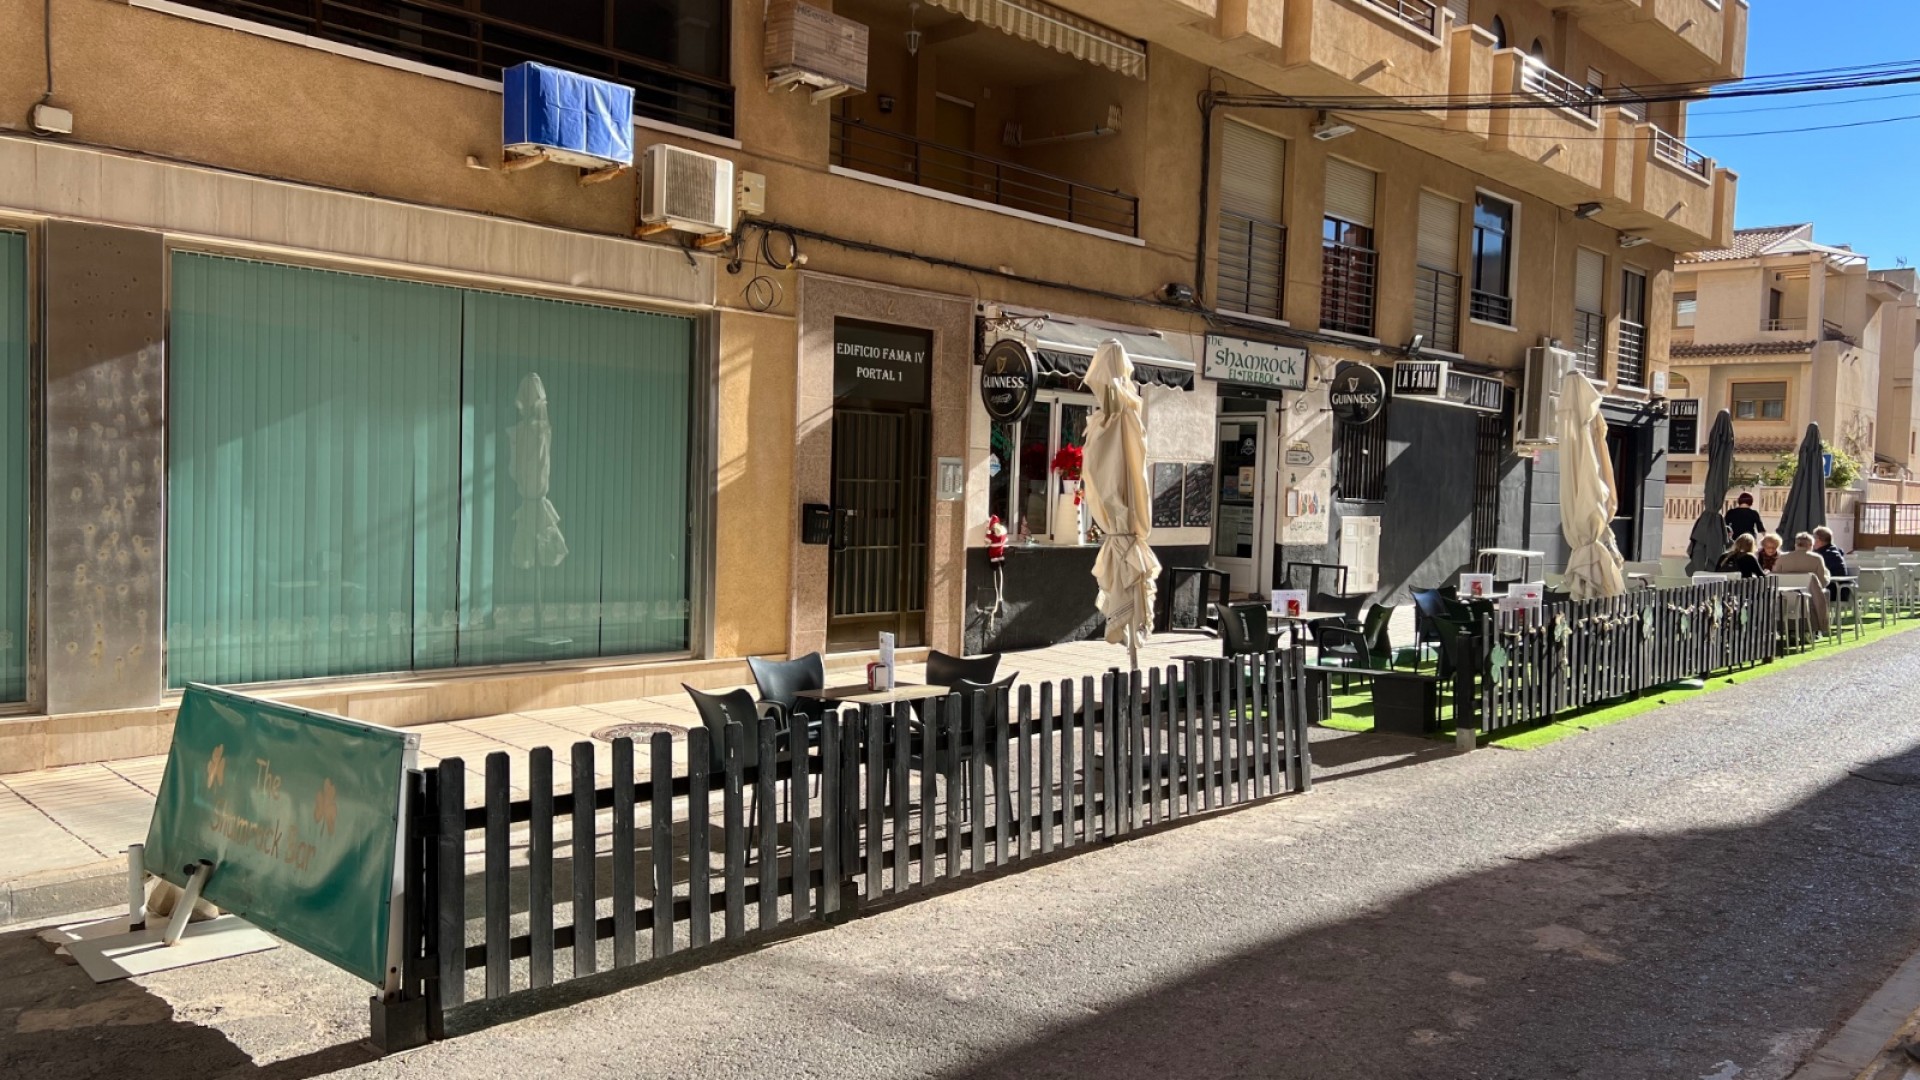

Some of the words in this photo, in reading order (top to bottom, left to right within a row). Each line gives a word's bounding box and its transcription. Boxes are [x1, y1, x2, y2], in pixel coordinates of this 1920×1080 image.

[836, 342, 880, 359] EDIFICIO
[882, 348, 912, 363] FAMA
[914, 352, 925, 363] IV
[856, 367, 895, 381] PORTAL
[1397, 370, 1409, 388] LA
[1411, 370, 1437, 389] FAMA
[983, 375, 1025, 389] GUINNESS
[1332, 393, 1377, 405] GUINNESS
[1671, 405, 1679, 416] LA
[1680, 405, 1697, 416] FAMA
[256, 758, 282, 800] The
